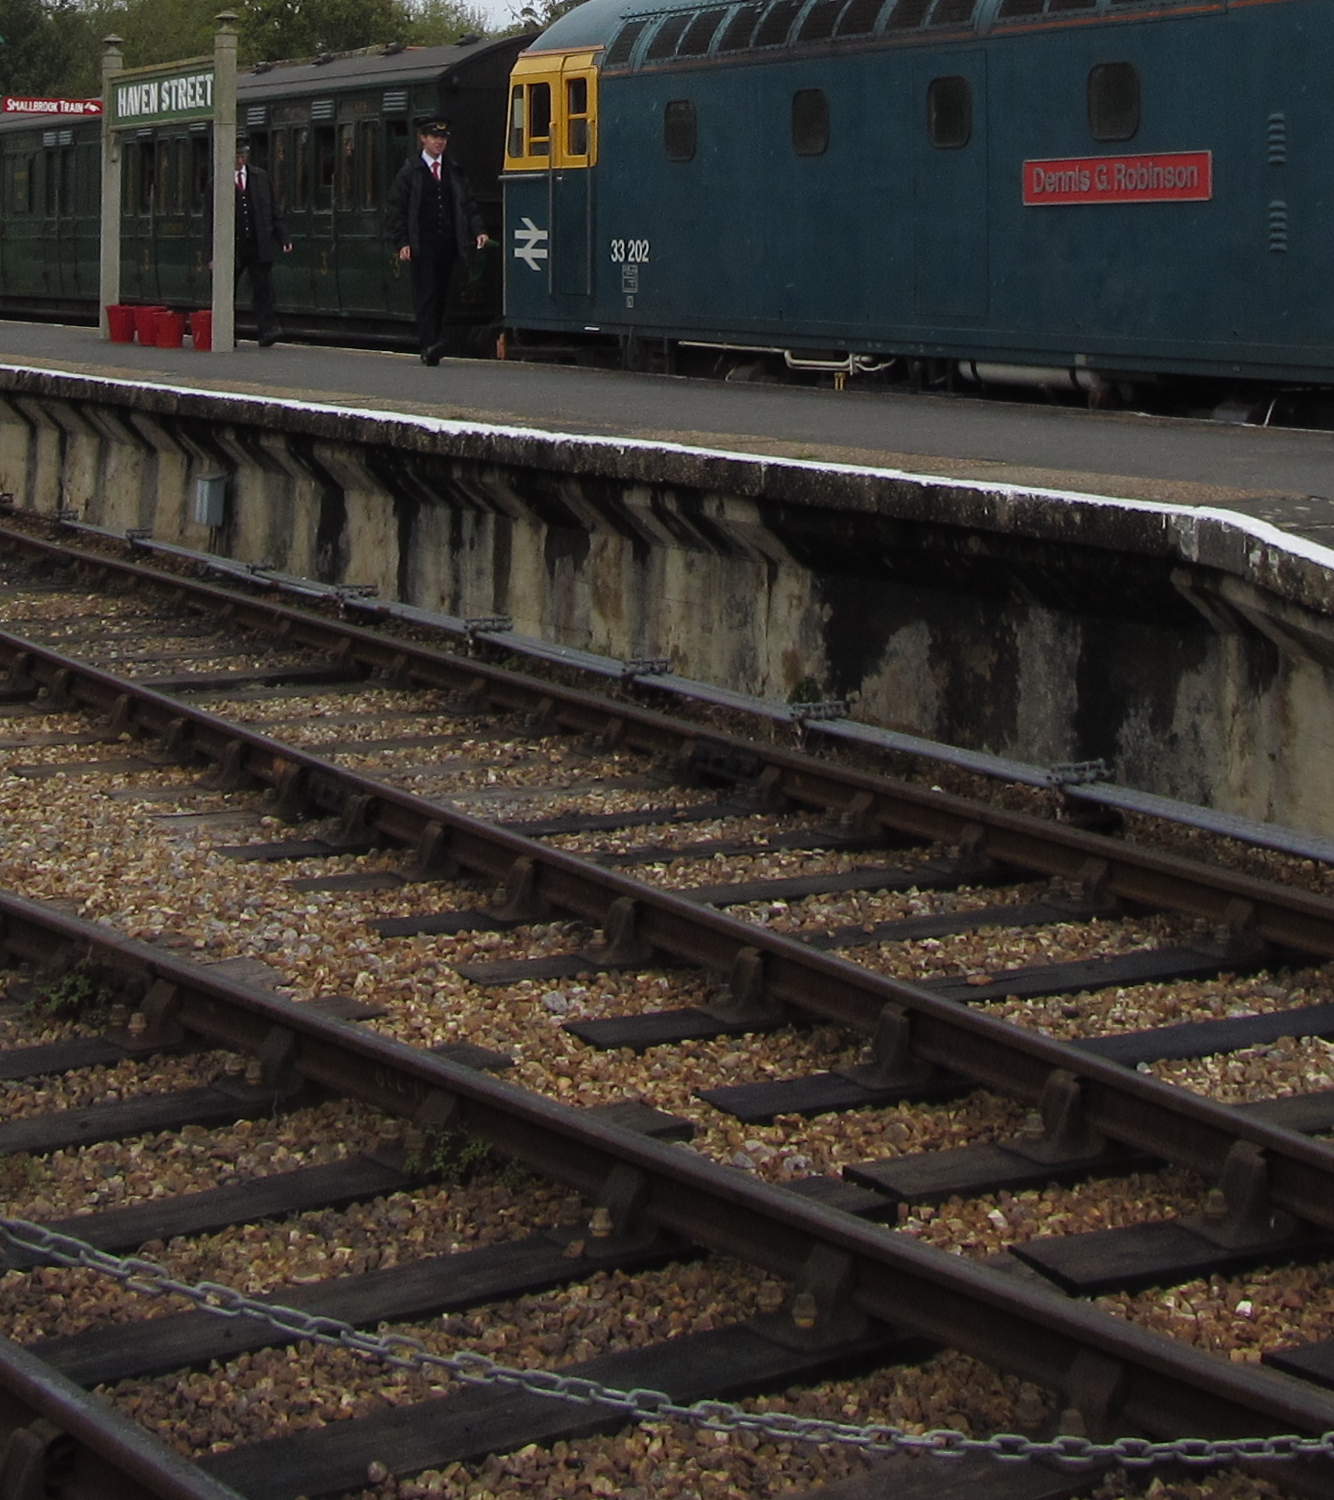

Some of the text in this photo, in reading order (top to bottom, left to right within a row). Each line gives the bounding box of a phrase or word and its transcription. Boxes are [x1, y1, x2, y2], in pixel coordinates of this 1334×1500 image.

[7, 98, 84, 113] SMALLBROOK TRAIN
[117, 73, 214, 118] HAVEN STREET
[1032, 161, 1199, 194] Dennis G. Robinson
[610, 239, 650, 263] 33 202
